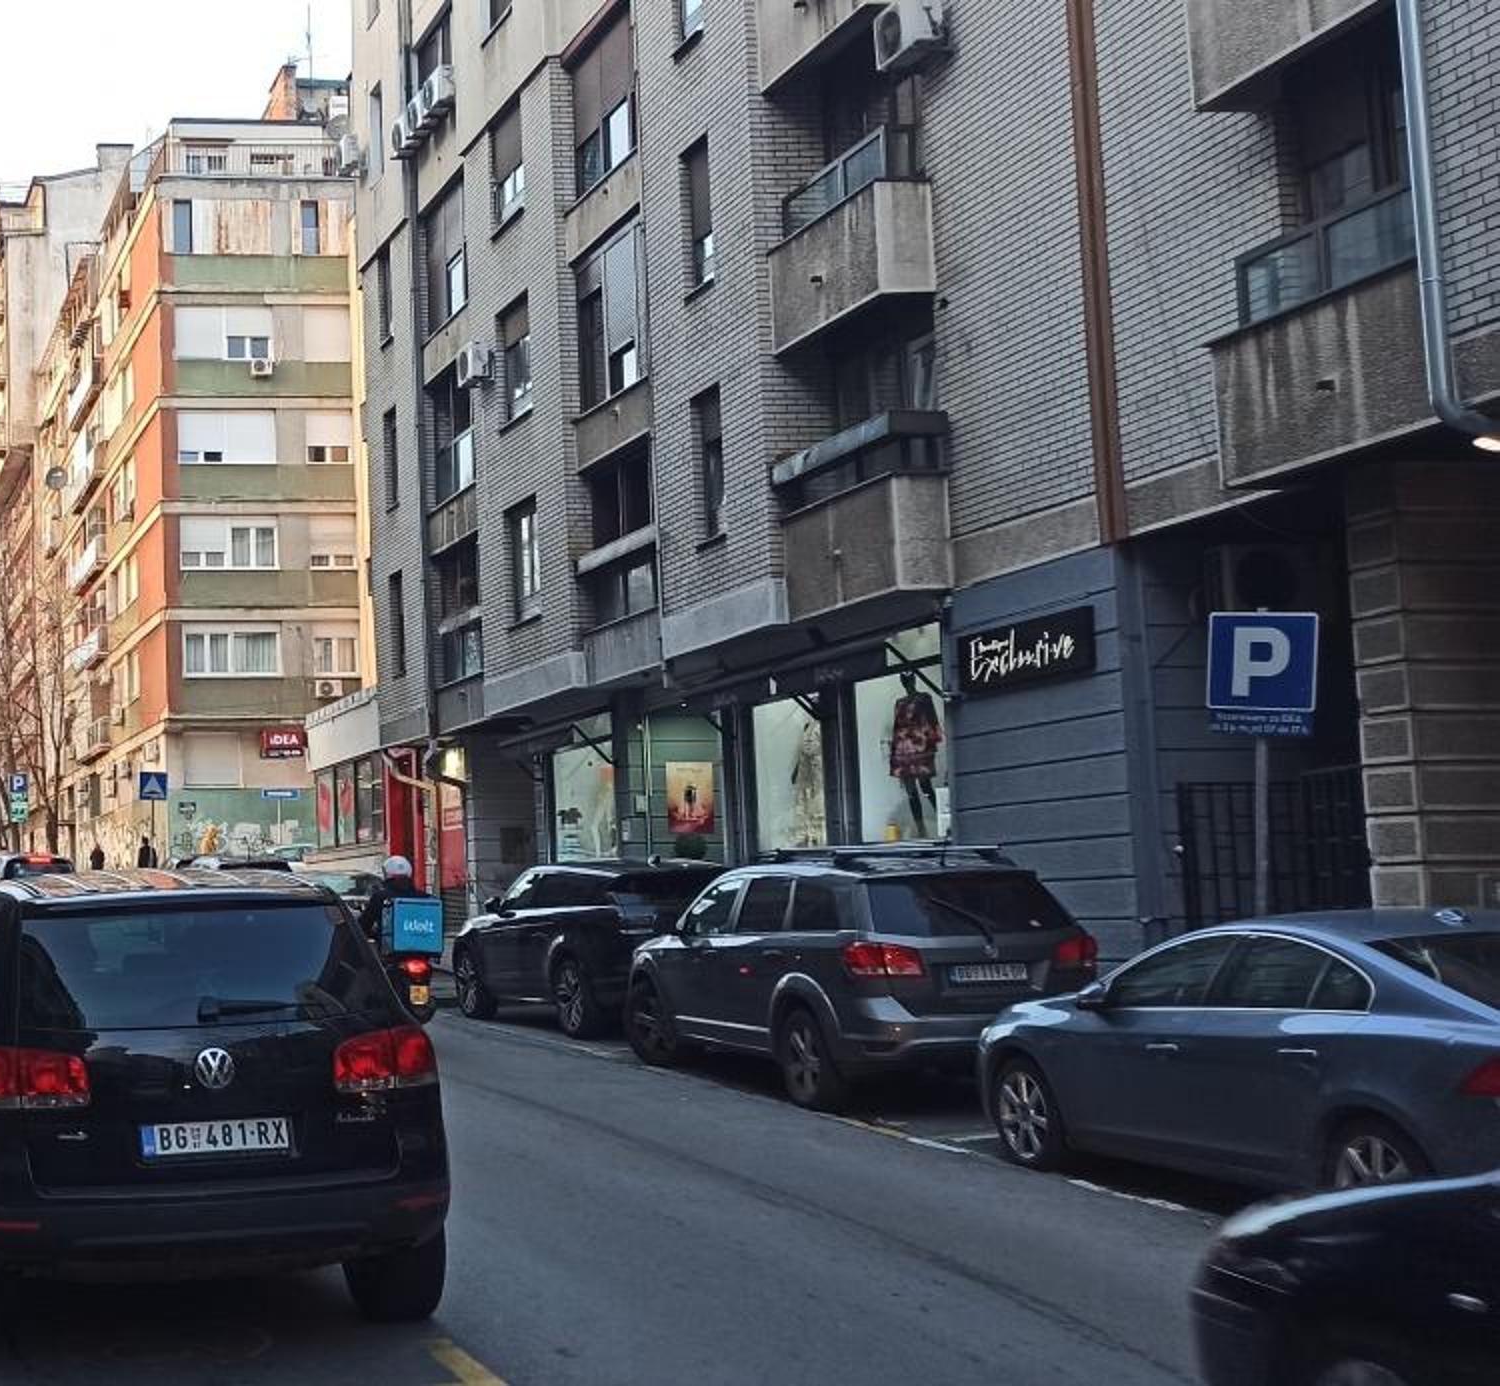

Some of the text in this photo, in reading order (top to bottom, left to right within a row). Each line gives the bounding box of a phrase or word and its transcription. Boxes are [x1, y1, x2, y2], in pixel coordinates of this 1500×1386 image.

[1231, 627, 1291, 697] P
[13, 775, 24, 791] P
[159, 1126, 187, 1150] BG
